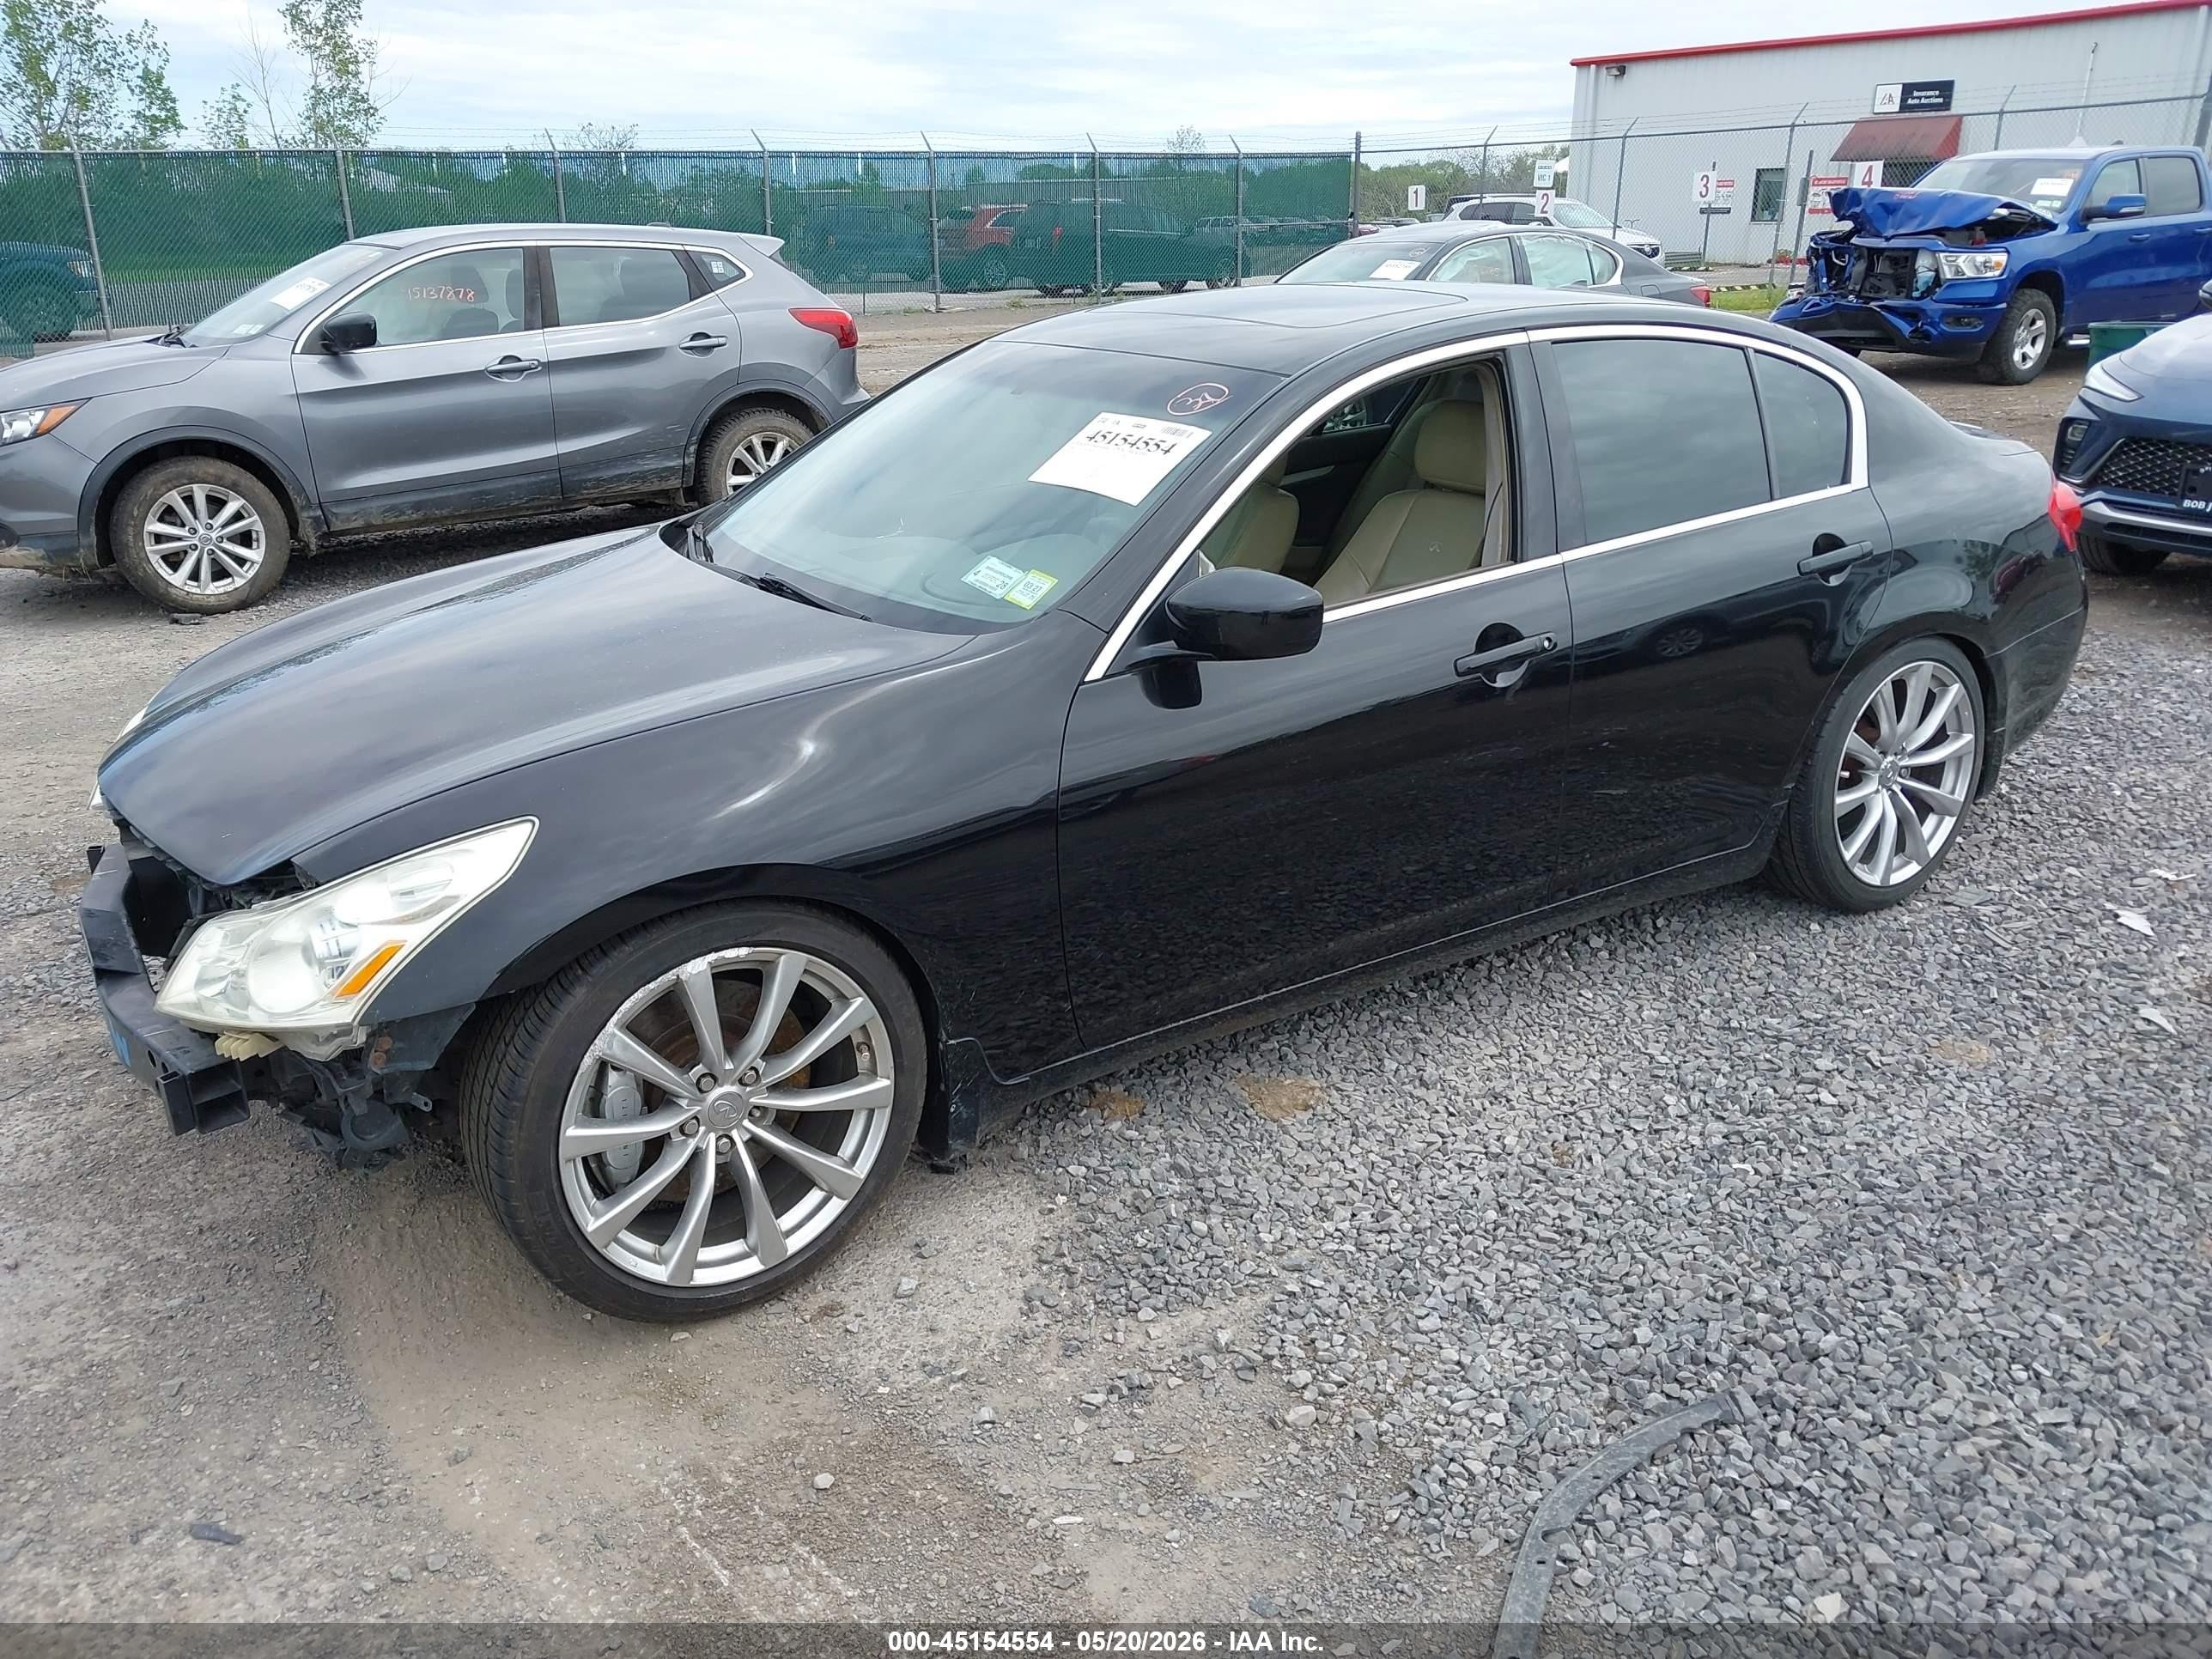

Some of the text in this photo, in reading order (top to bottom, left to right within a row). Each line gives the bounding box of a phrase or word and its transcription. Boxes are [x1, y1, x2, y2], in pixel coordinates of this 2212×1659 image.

[1699, 174, 1710, 198] 3
[1861, 165, 1873, 187] 4
[1413, 187, 1418, 207] 1
[1540, 193, 1549, 214] 2
[408, 286, 474, 302] 15137878
[1086, 430, 1177, 454] 45154554
[2183, 499, 2206, 509] BOB
